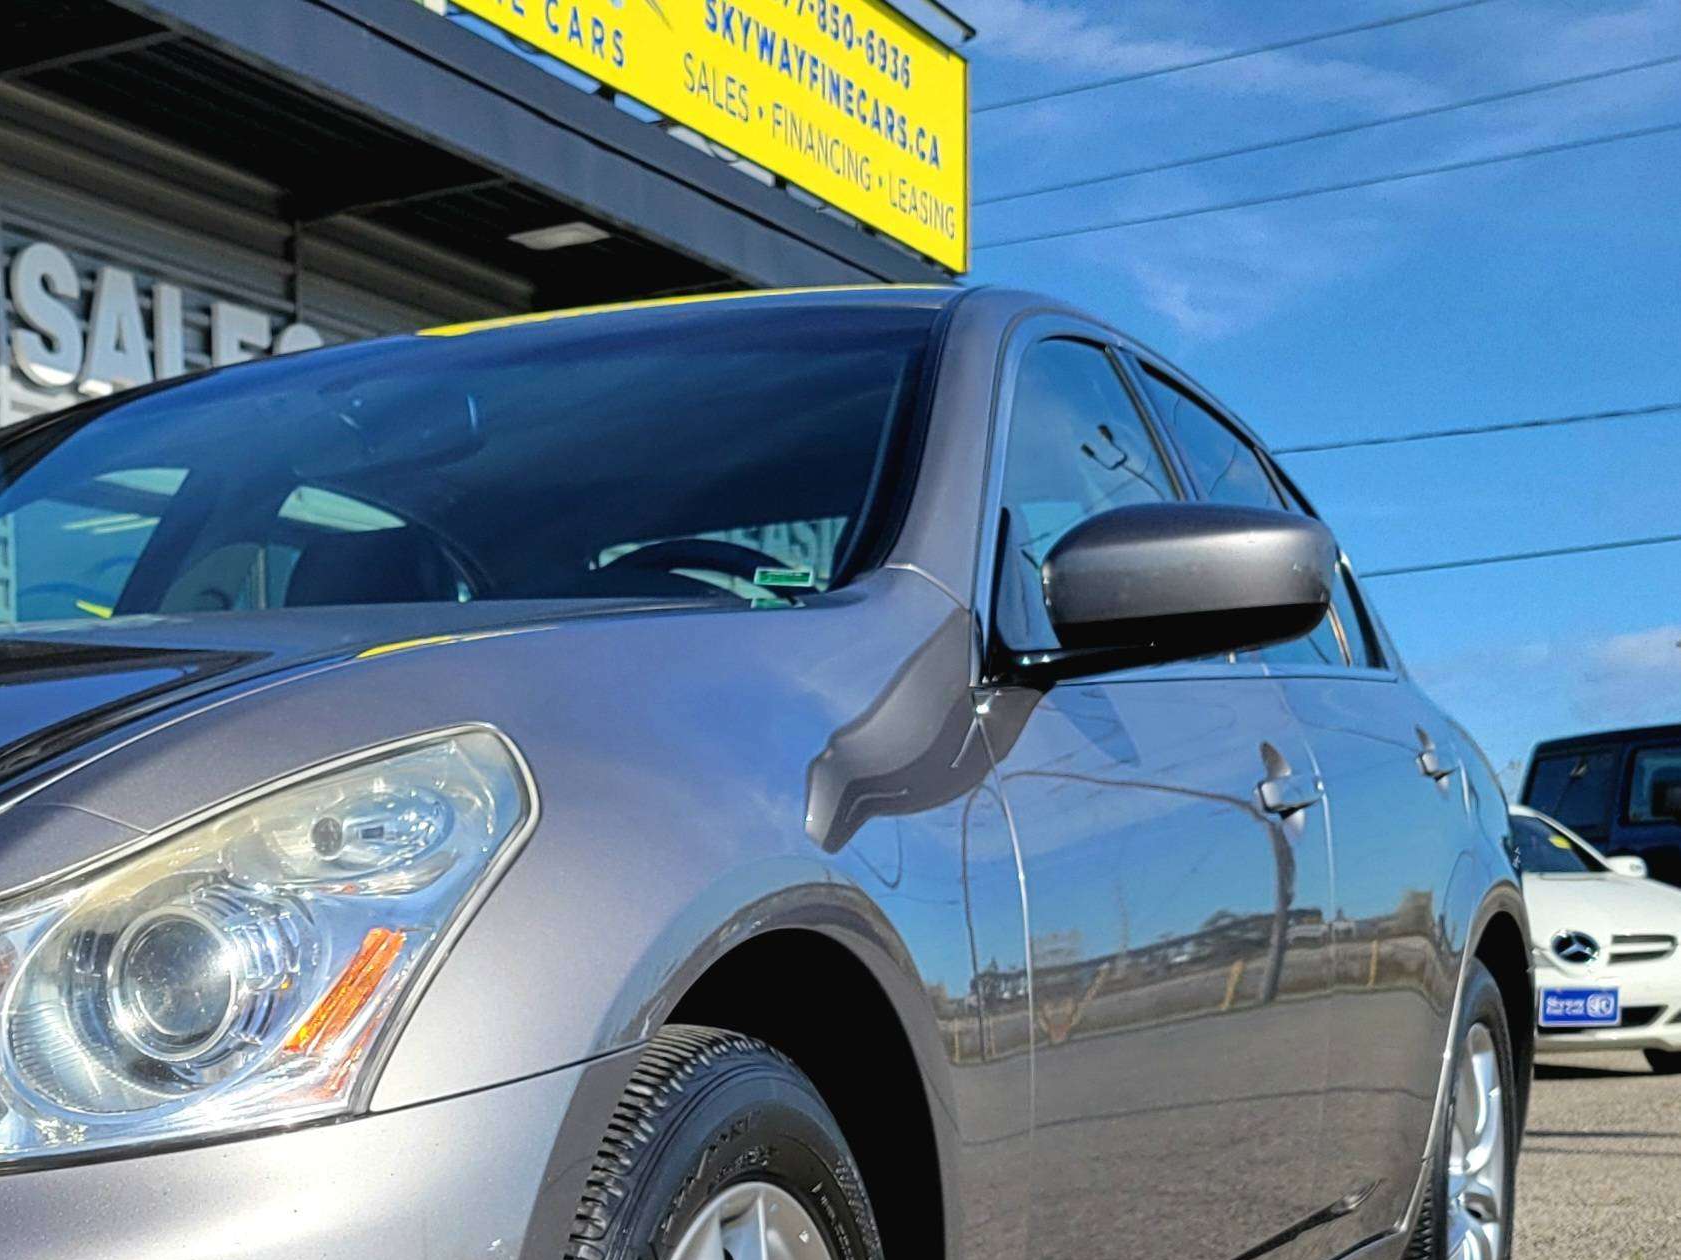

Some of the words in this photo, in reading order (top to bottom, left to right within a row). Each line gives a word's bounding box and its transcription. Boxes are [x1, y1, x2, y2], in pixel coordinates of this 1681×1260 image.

[544, 0, 625, 68] CARS
[704, 0, 941, 170] SKYWAYFINECARS.CA
[783, 0, 912, 90] -850-6936
[683, 52, 749, 122] SALES
[771, 102, 872, 192] FINANCING
[887, 170, 956, 240] LEASING
[9, 242, 324, 396] SALE
